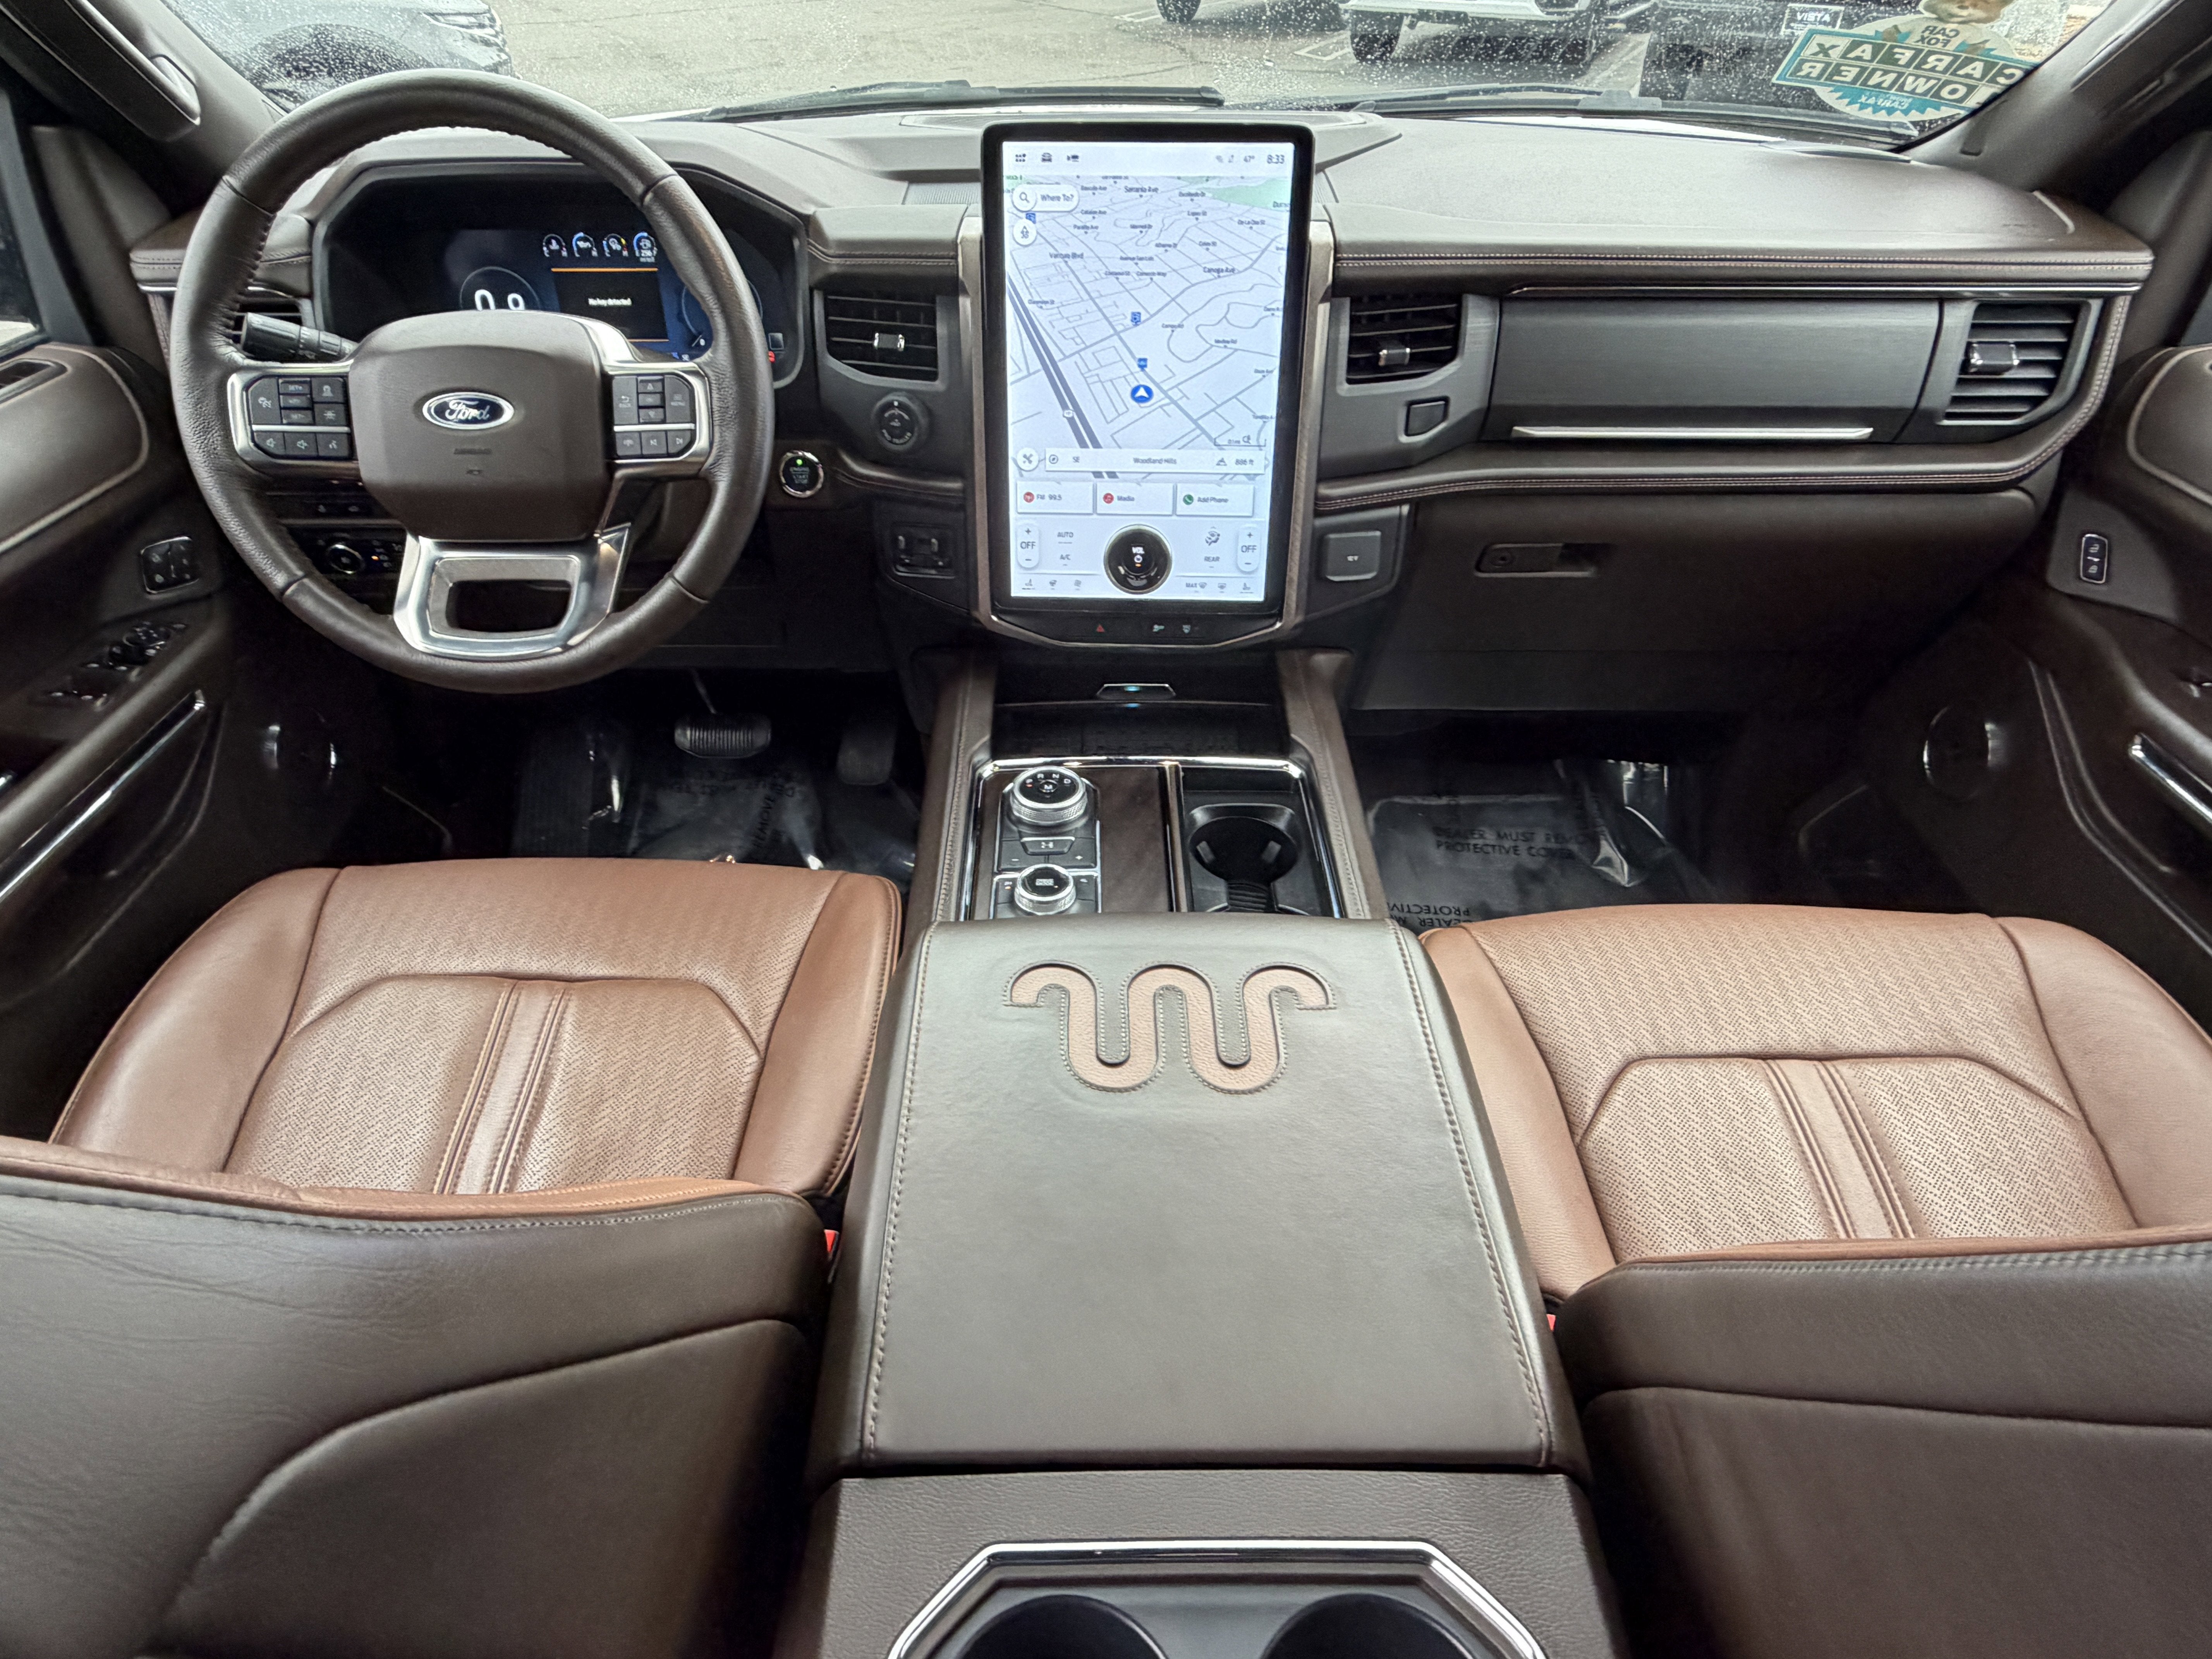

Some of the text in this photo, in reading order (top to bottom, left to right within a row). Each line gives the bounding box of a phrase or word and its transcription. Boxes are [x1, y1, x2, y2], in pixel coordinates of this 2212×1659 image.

[1267, 154, 1285, 164] 8:33
[445, 399, 490, 422] Ford
[1020, 541, 1036, 550] OFF
[1241, 545, 1257, 553] OFF
[1496, 828, 1535, 842] MUST
[1436, 840, 1521, 856] PROTECTIVE
